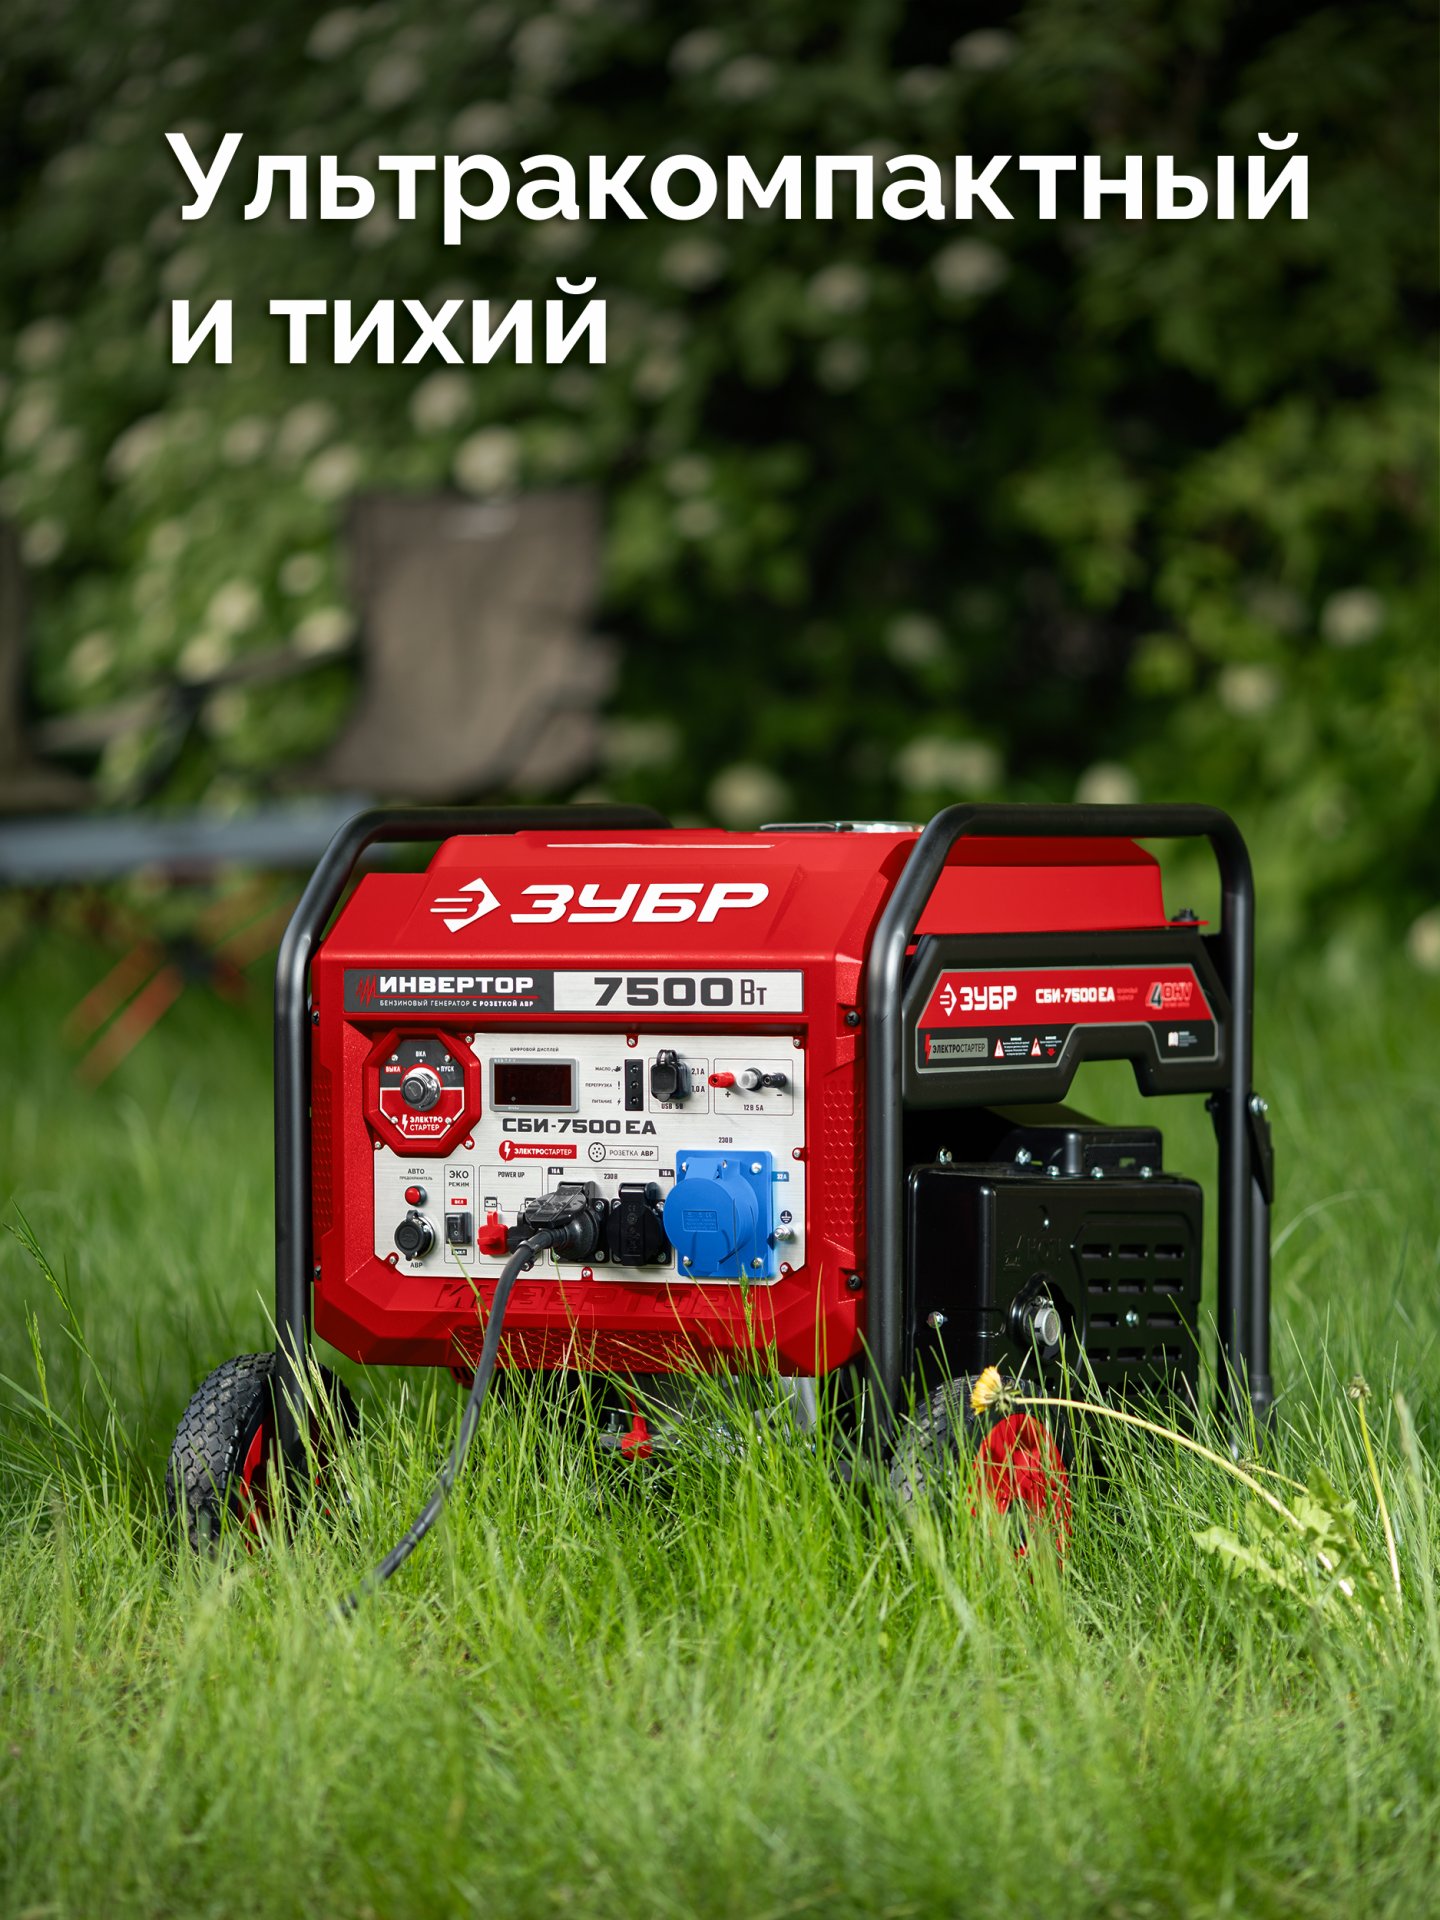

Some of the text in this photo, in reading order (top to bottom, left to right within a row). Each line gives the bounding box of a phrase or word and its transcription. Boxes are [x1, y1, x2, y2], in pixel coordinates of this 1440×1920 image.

[511, 883, 769, 923] ЗУБР
[379, 976, 534, 994] ИНВЕРТОР
[594, 977, 767, 1006] 7500 Вт
[379, 999, 428, 1007] БЕНЗИНОВЫЙ
[430, 1000, 470, 1008] ГЕНЕРАТОР
[479, 999, 517, 1008] РОЗЕТКОЙ
[959, 985, 1017, 1011] ЗУБР
[932, 1043, 985, 1054] ЭЛЕКТРОСТАРТЕР
[385, 1065, 401, 1073] ВЫКЛ
[502, 1118, 621, 1134] СБИ-7500
[514, 1148, 573, 1156] ЭЛЕКТРОСТАРТЕР
[449, 1170, 469, 1179] ЭКО
